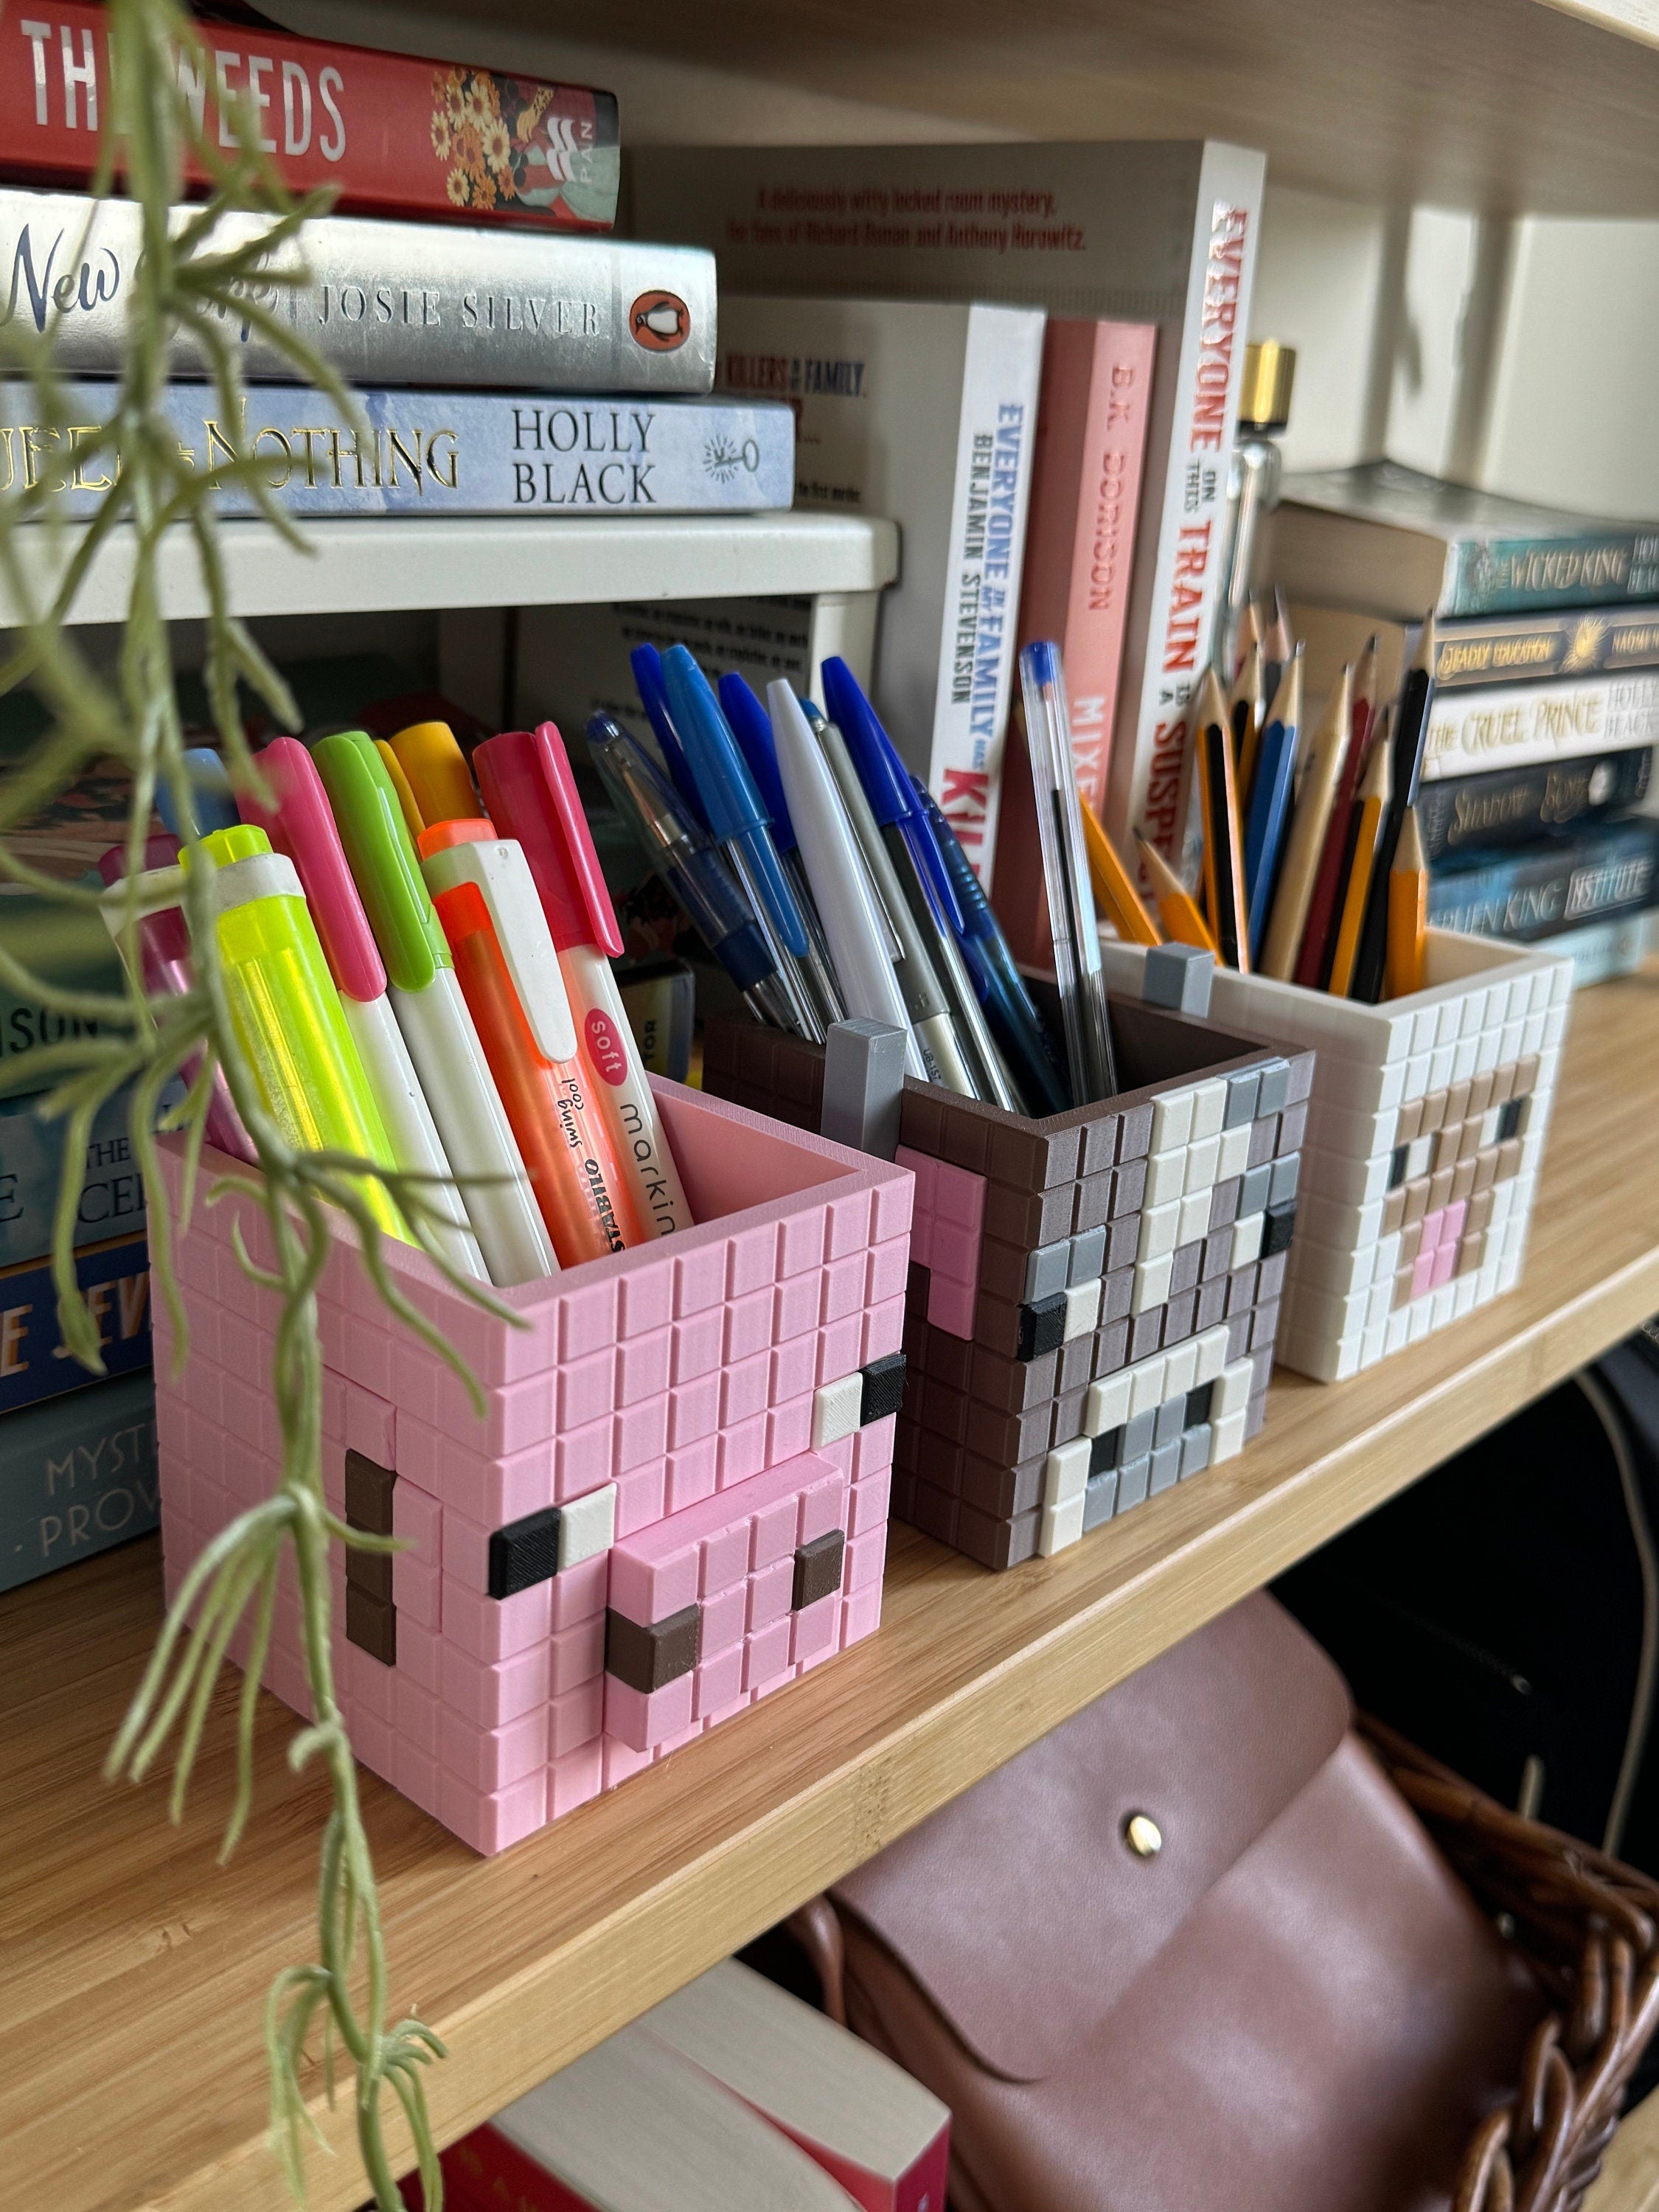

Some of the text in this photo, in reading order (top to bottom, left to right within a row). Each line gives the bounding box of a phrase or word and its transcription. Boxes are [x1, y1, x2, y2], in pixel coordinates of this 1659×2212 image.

[21, 19, 133, 134] TH
[580, 121, 594, 184] PAN
[0, 223, 119, 333] New
[319, 285, 440, 326] JOSIE
[462, 291, 600, 336] SILVER
[1187, 200, 1248, 455] EVERYONE
[512, 409, 655, 452] HOLLY
[512, 462, 656, 504] BLACK
[984, 403, 1024, 580] EVERYONE
[951, 434, 994, 705] BENJAMIN STEVENSON
[1163, 520, 1212, 674] TRAIN
[1579, 549, 1626, 587] KING
[970, 616, 1004, 738] FAMILY
[1071, 695, 1107, 807] MIXE
[1532, 689, 1601, 751] PRINCE
[591, 1020, 622, 1074] soft
[923, 1048, 941, 1081] UB-157
[557, 1099, 582, 1148] swing
[562, 1078, 584, 1110] cool
[585, 1158, 626, 1253] STABILO
[45, 1424, 156, 1495] MYST
